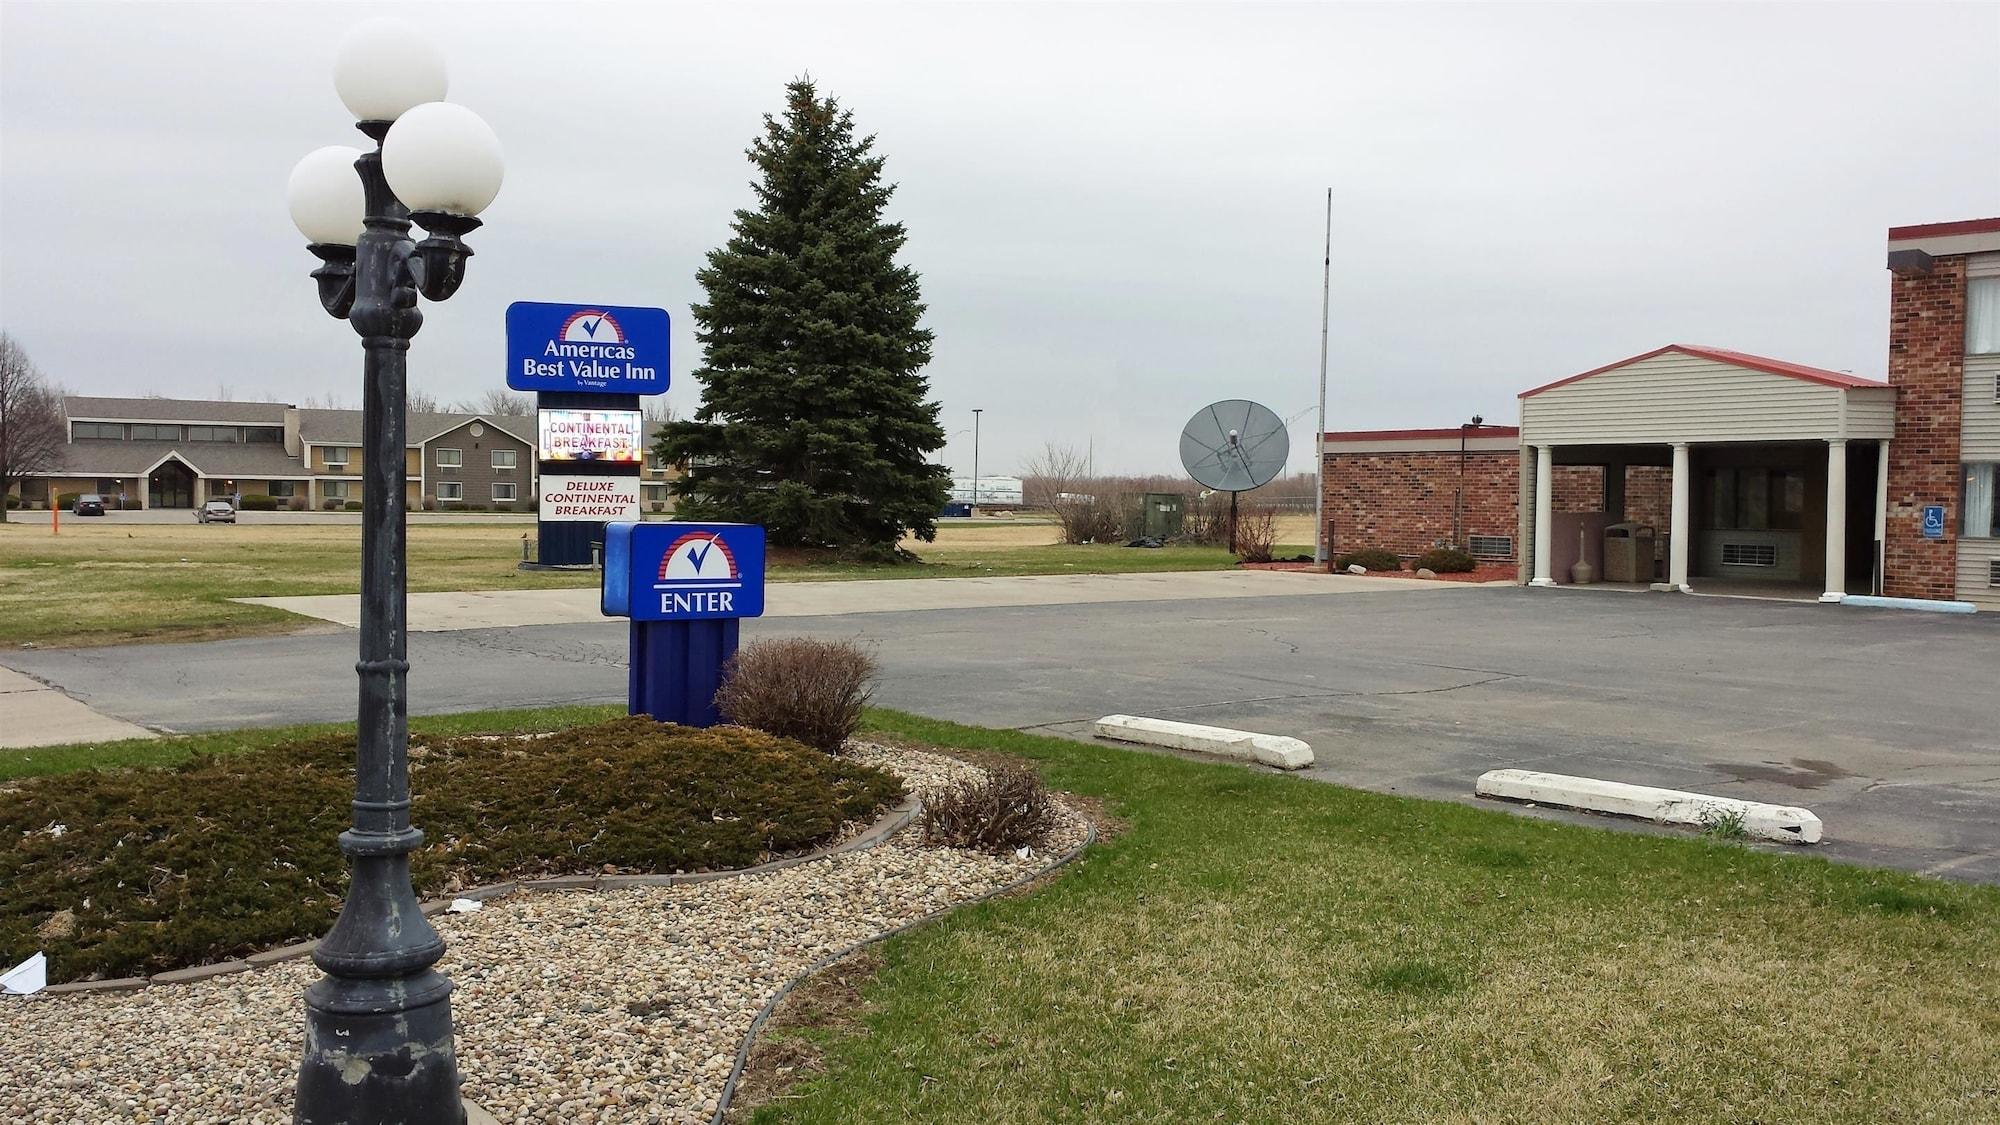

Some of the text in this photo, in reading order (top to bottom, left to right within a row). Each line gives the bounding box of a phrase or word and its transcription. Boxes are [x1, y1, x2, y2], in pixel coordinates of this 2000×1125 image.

[543, 339, 635, 360] Americas
[523, 358, 656, 380] Best Value Inn
[550, 422, 633, 435] CONTINENTAL
[554, 436, 627, 449] BREAKFAST
[566, 481, 615, 492] DELUXE
[545, 493, 636, 504] CONTINENTAL
[555, 506, 626, 516] BREAKFAST
[660, 591, 734, 614] ENTER
